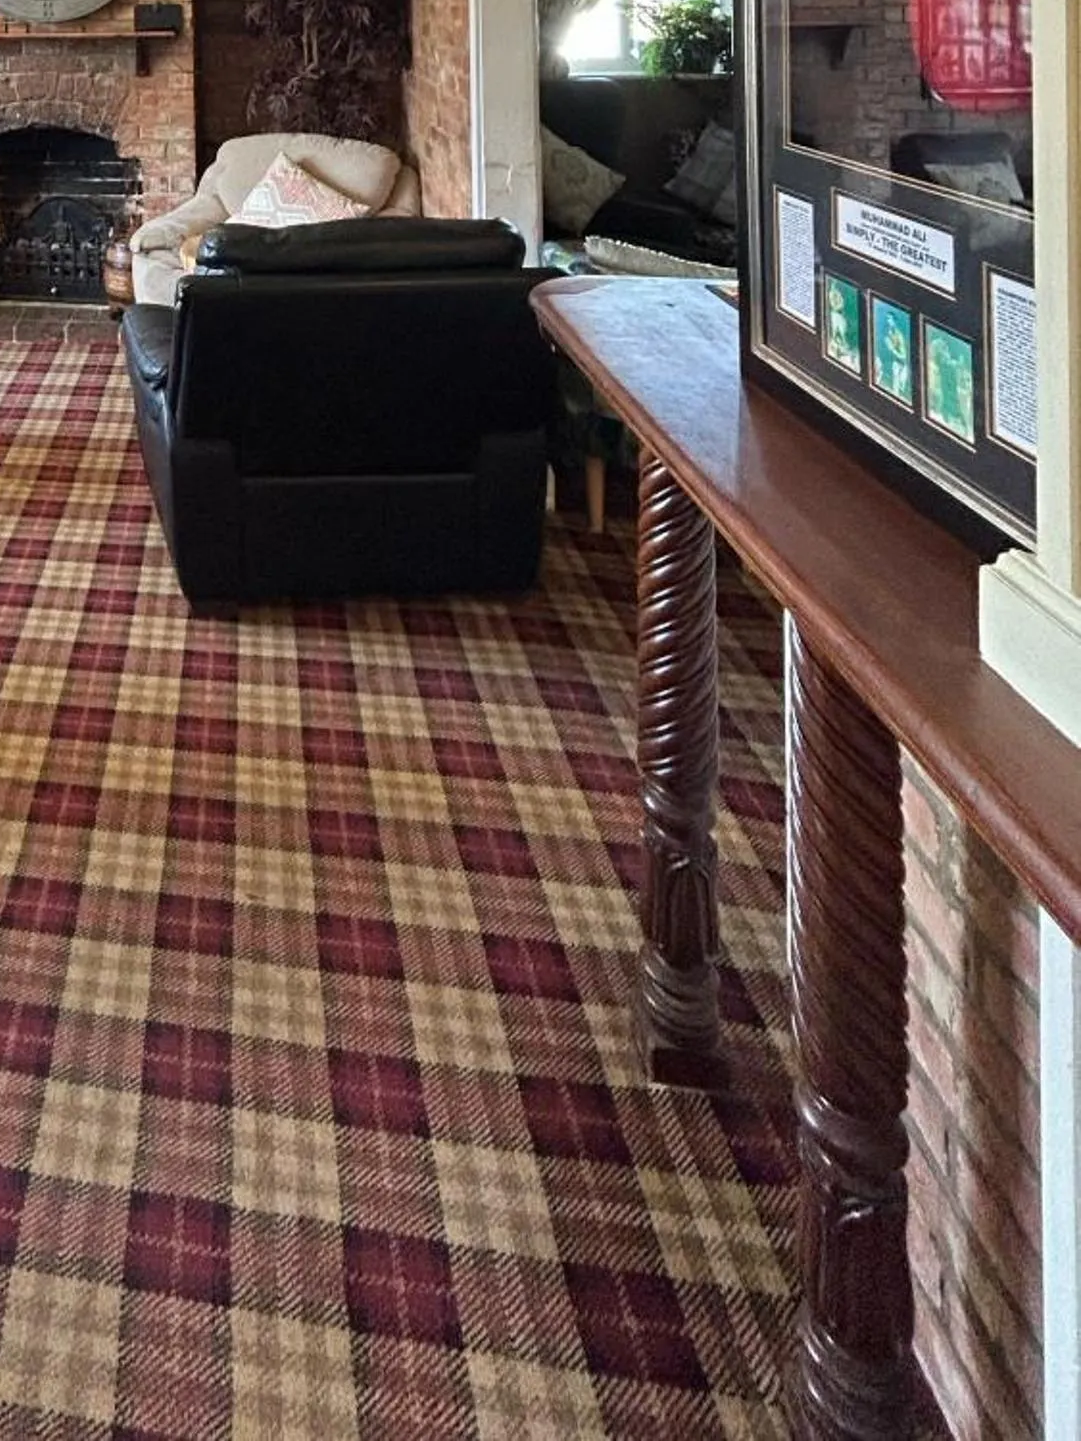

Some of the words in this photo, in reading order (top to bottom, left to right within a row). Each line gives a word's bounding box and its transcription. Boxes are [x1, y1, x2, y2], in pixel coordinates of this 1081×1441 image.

[846, 222, 876, 242] SIMPLY
[882, 236, 899, 252] THE
[900, 244, 947, 272] GREATEST
[861, 209, 910, 236] MUHAMMAD
[912, 228, 927, 243] ALI
